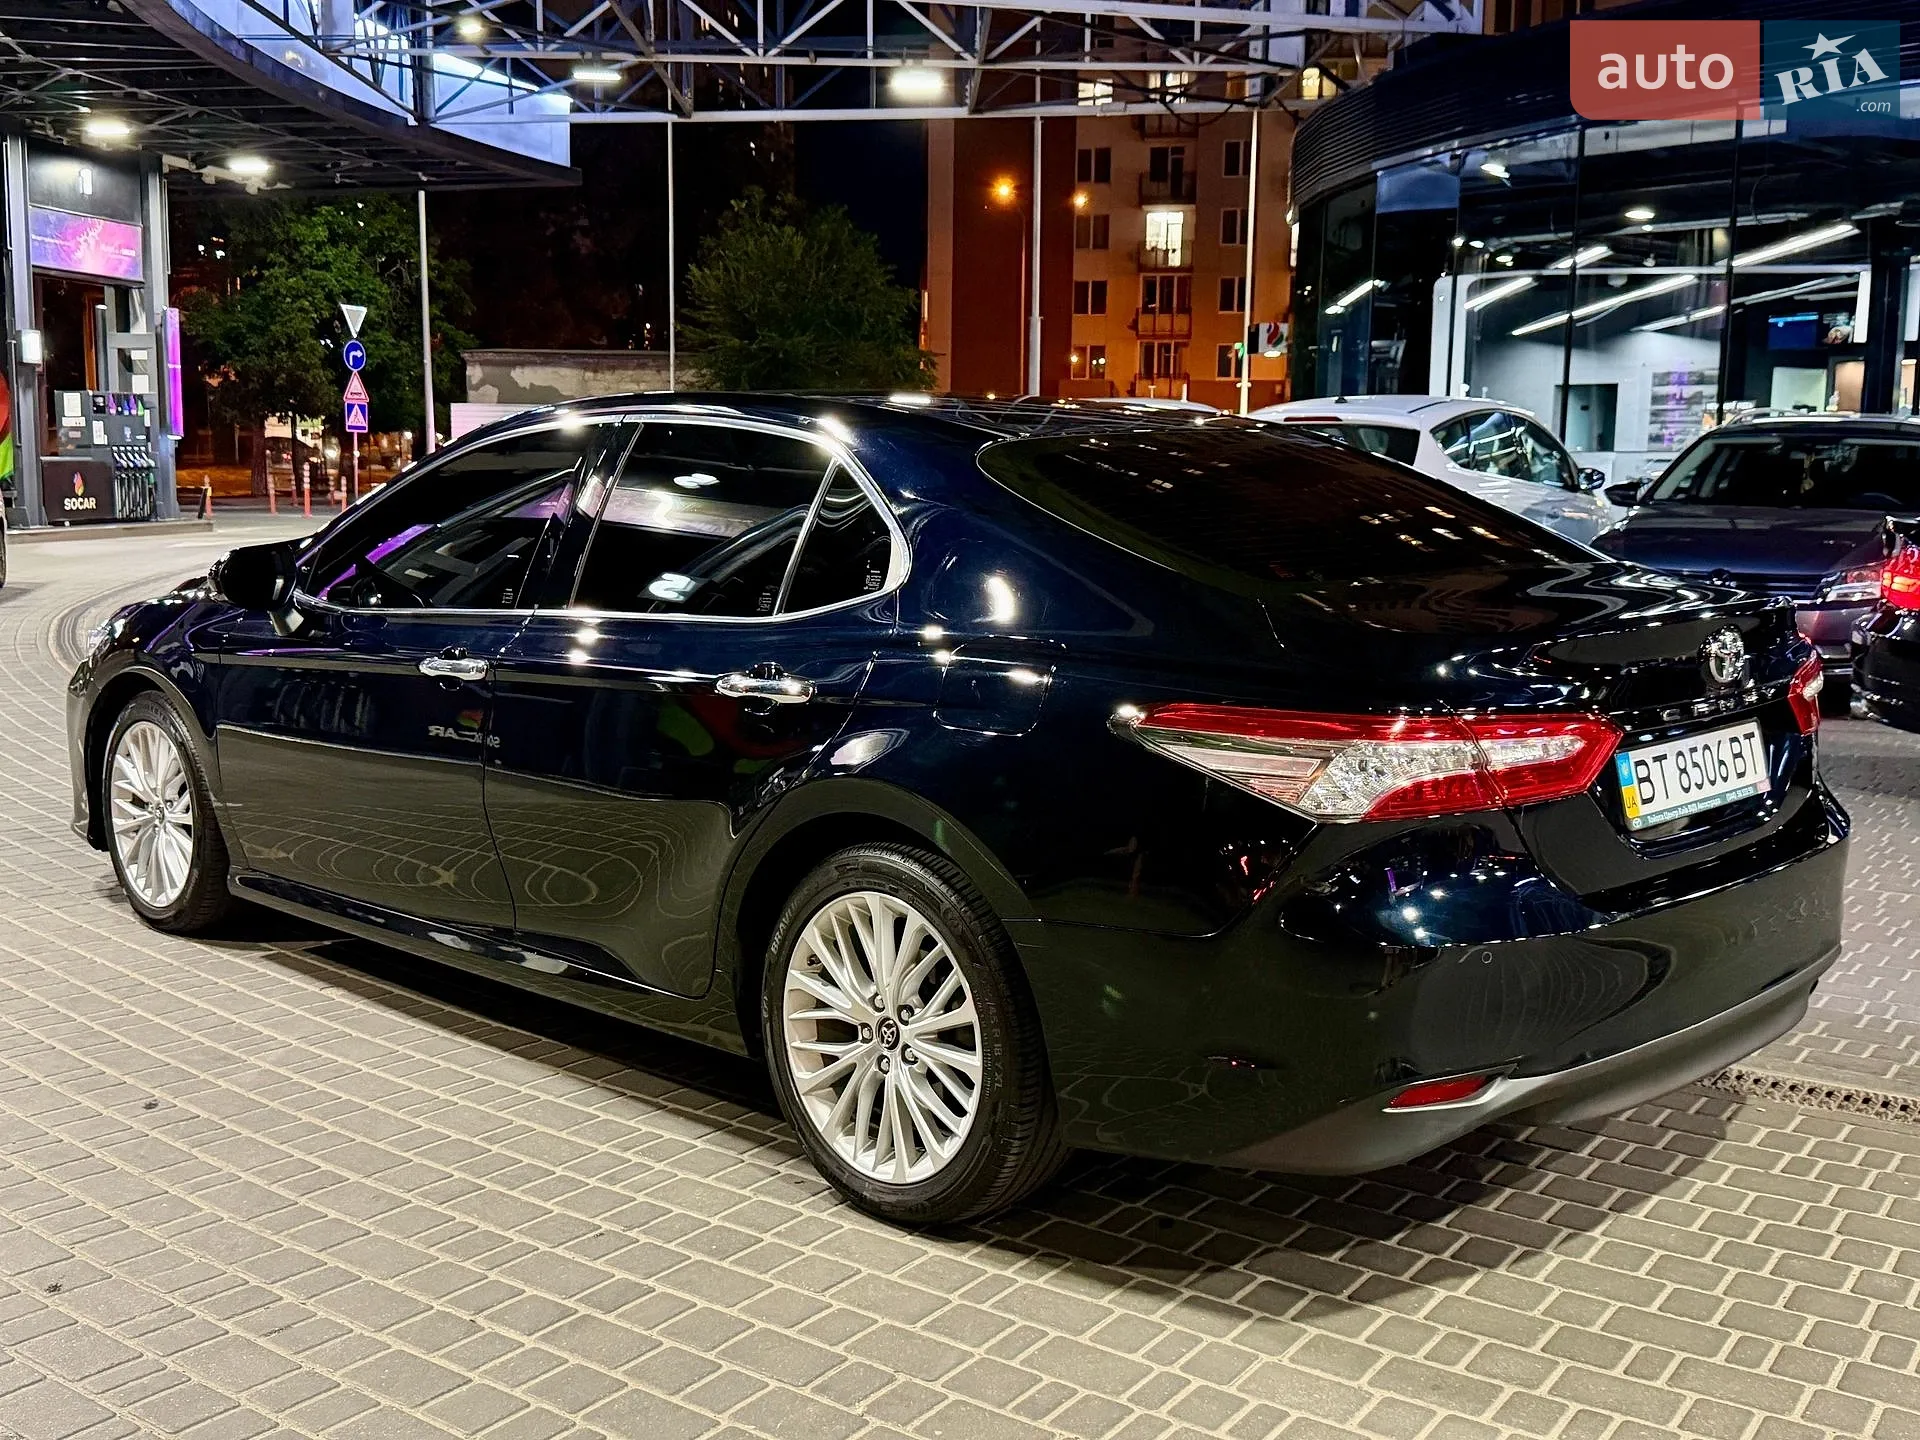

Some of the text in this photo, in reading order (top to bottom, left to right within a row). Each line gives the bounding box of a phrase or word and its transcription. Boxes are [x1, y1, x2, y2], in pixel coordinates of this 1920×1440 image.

[64, 497, 96, 510] SOCAR
[1634, 732, 1758, 805] BT 8506 BT
[1626, 796, 1637, 809] UA
